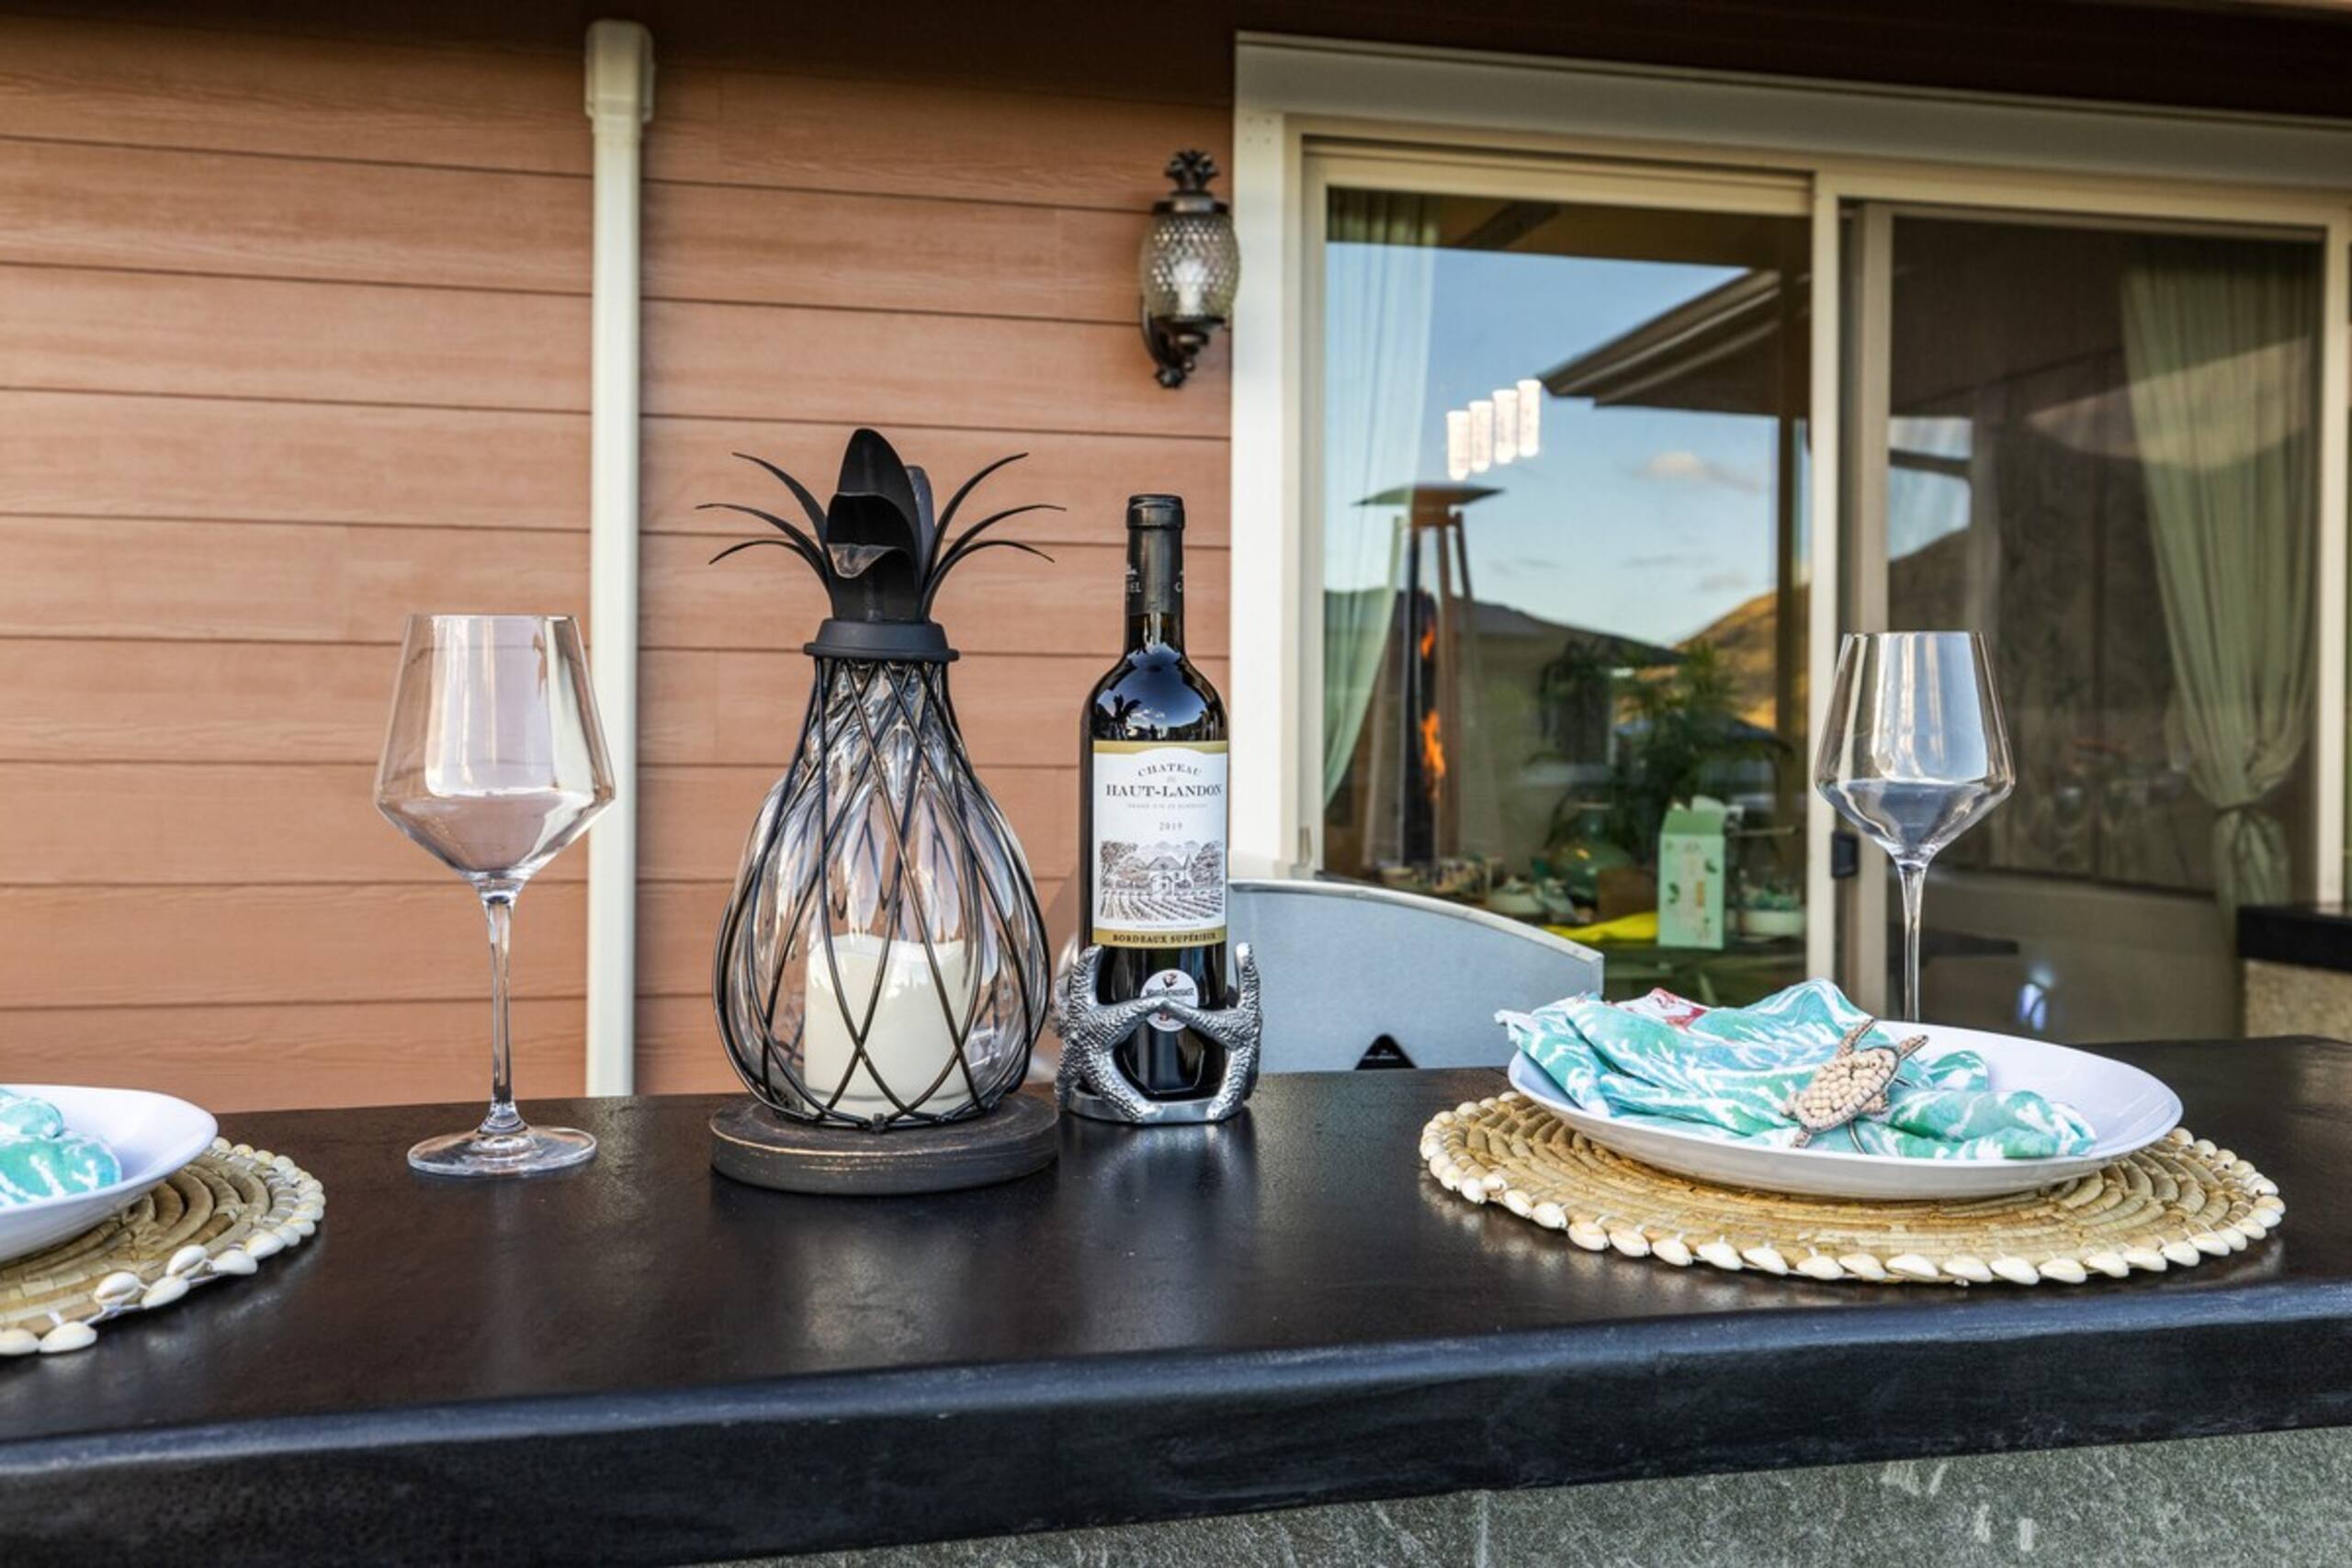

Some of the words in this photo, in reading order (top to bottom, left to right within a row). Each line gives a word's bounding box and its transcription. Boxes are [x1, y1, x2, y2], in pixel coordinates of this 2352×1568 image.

[1106, 783, 1223, 798] HAUT-LANDON
[1159, 821, 1183, 831] 2019
[1113, 933, 1167, 944] BORDEAUX
